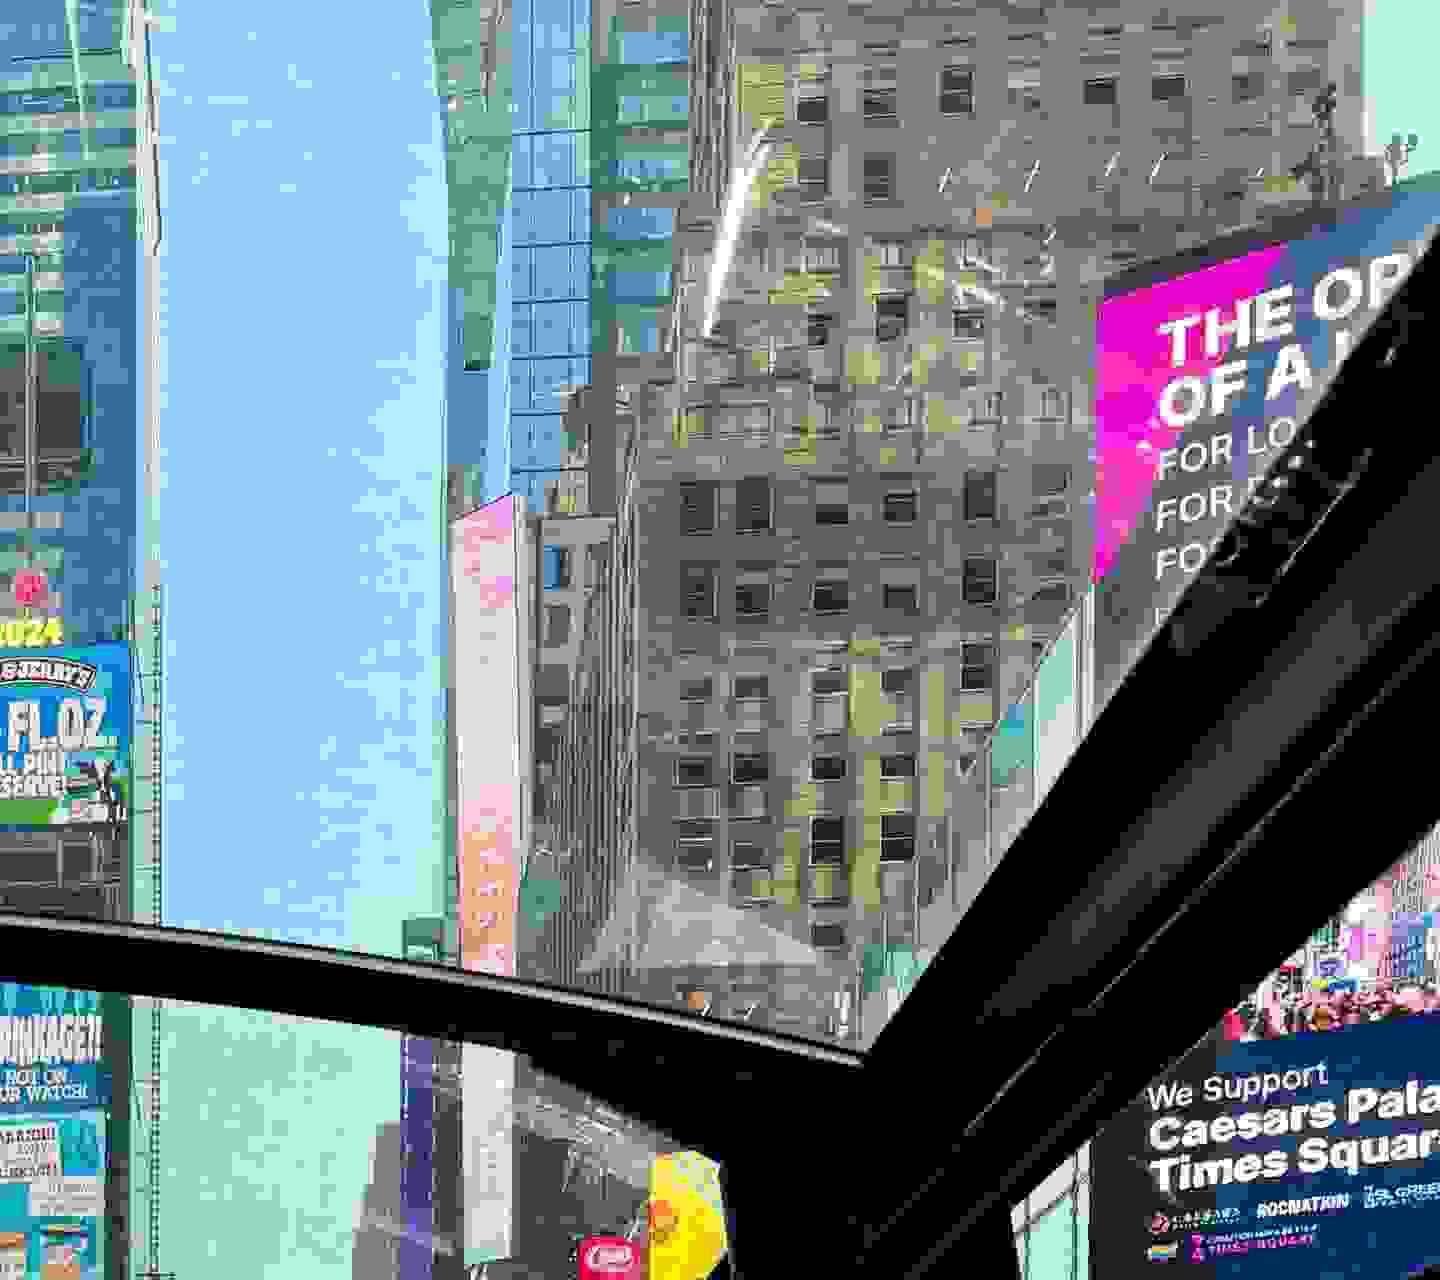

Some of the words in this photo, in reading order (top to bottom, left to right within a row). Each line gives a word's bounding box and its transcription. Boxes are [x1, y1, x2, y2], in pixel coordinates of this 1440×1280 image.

[1156, 282, 1294, 368] THE
[1313, 253, 1413, 321] OP
[1159, 360, 1248, 428] OF
[1266, 343, 1312, 401] A
[1156, 433, 1233, 480] FOR
[1247, 416, 1296, 455] LO
[1155, 485, 1233, 534] FOR
[1155, 538, 1223, 582] FO
[23, 750, 64, 777] PINT
[1146, 1083, 1193, 1111] We
[1204, 1061, 1328, 1102] Support
[1149, 1102, 1337, 1151] Caesars
[1149, 1148, 1289, 1195] Times
